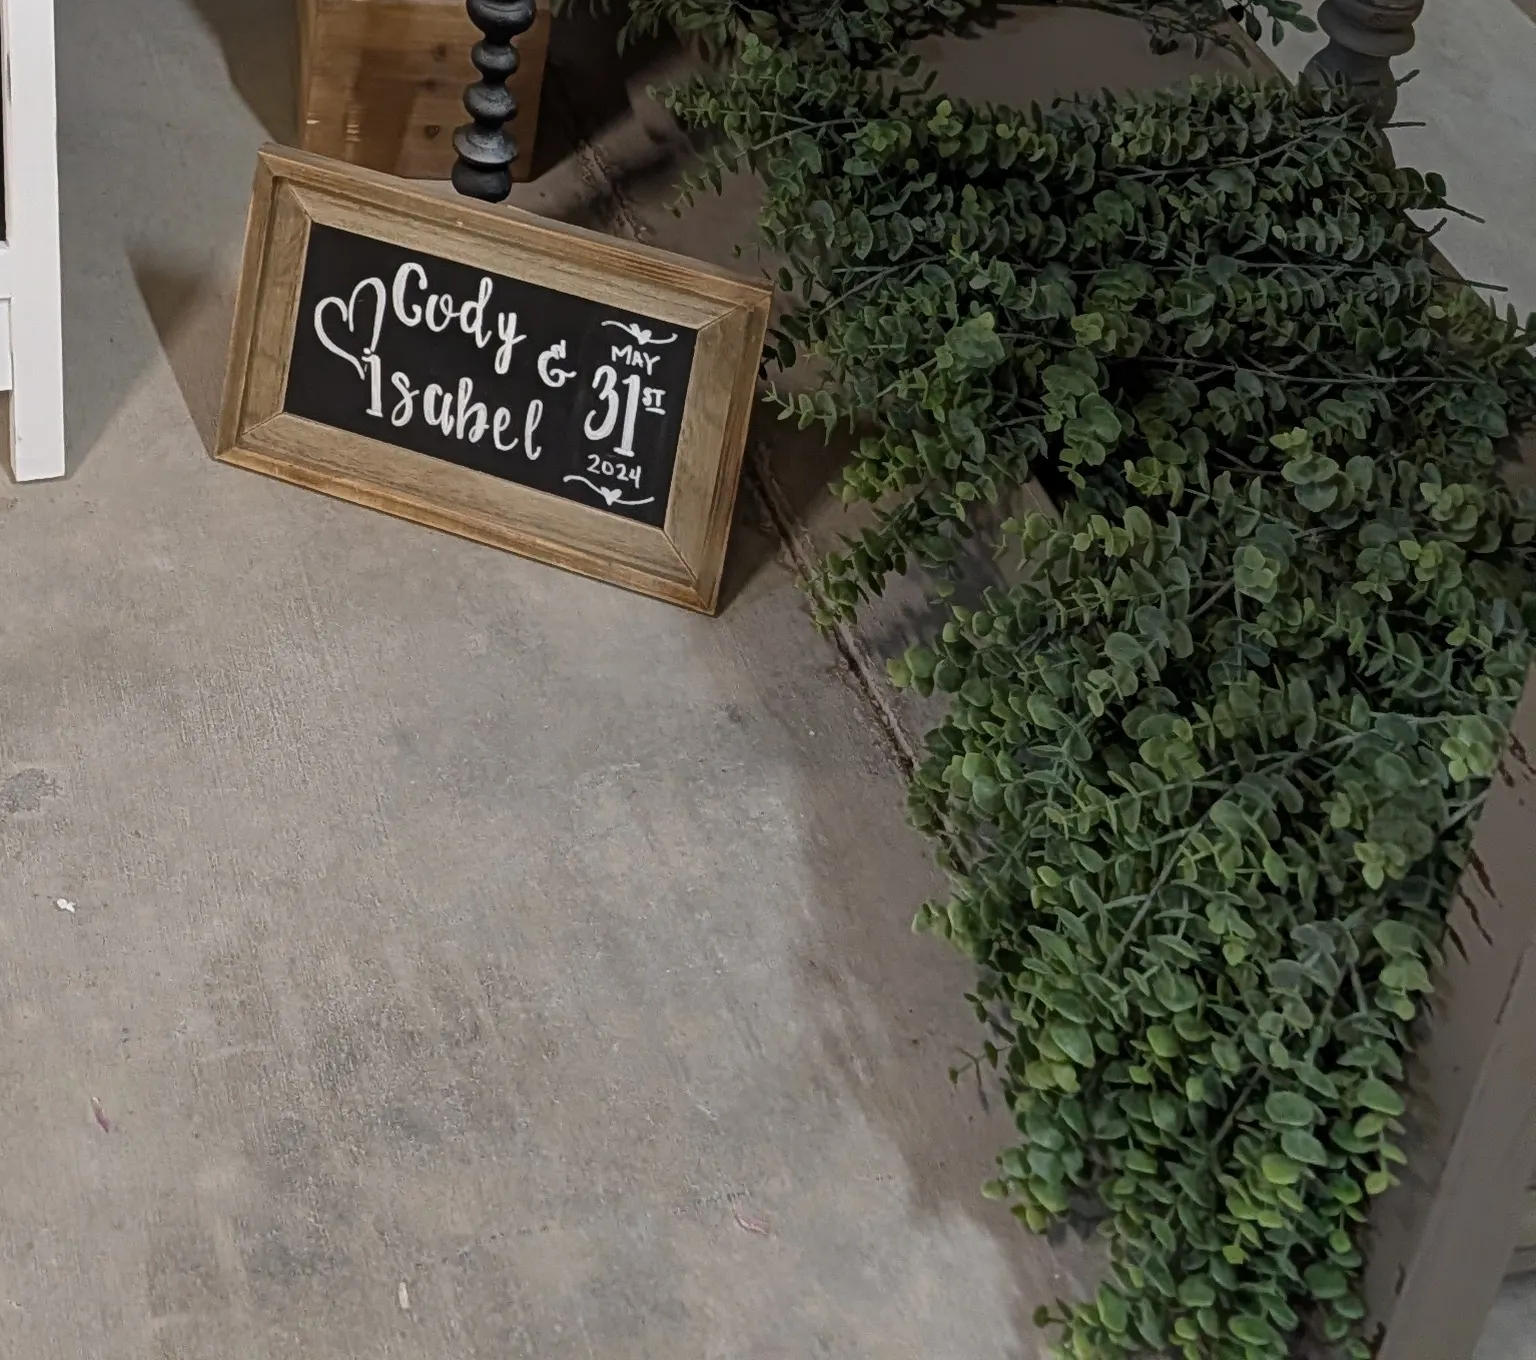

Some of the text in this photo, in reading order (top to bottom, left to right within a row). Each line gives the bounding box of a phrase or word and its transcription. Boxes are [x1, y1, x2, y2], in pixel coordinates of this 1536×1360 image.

[392, 262, 576, 386] Cody &
[611, 345, 661, 376] MAY
[362, 348, 542, 460] Isabel
[587, 454, 642, 488] 2024
